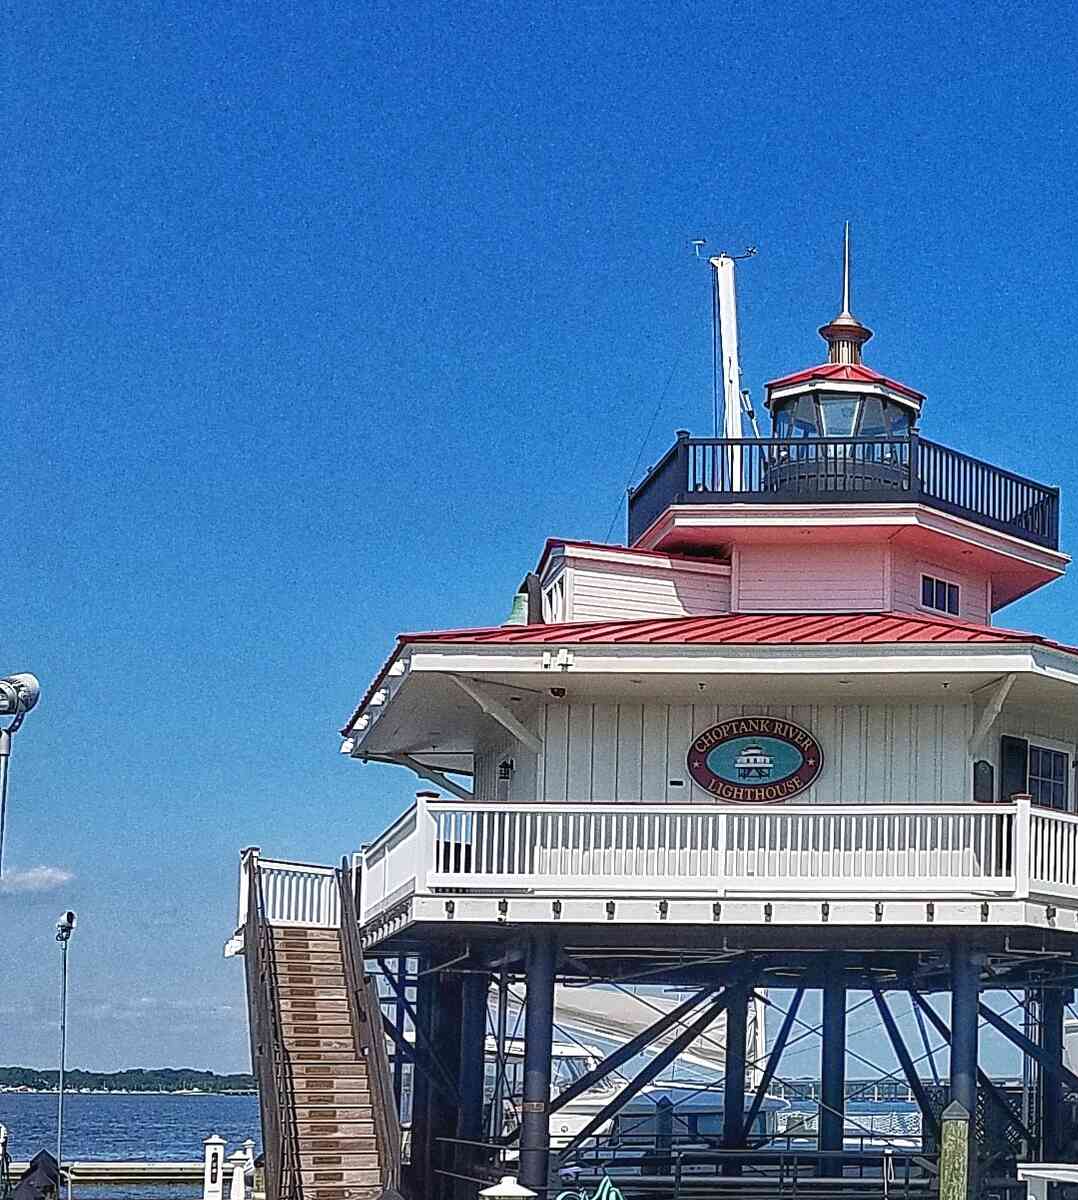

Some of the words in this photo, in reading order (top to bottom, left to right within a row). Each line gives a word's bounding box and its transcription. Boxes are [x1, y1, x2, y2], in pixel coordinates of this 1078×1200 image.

[694, 719, 771, 753] CHOPTANK
[773, 721, 813, 752] RIVER
[707, 775, 804, 800] LIGHTHOUSE
